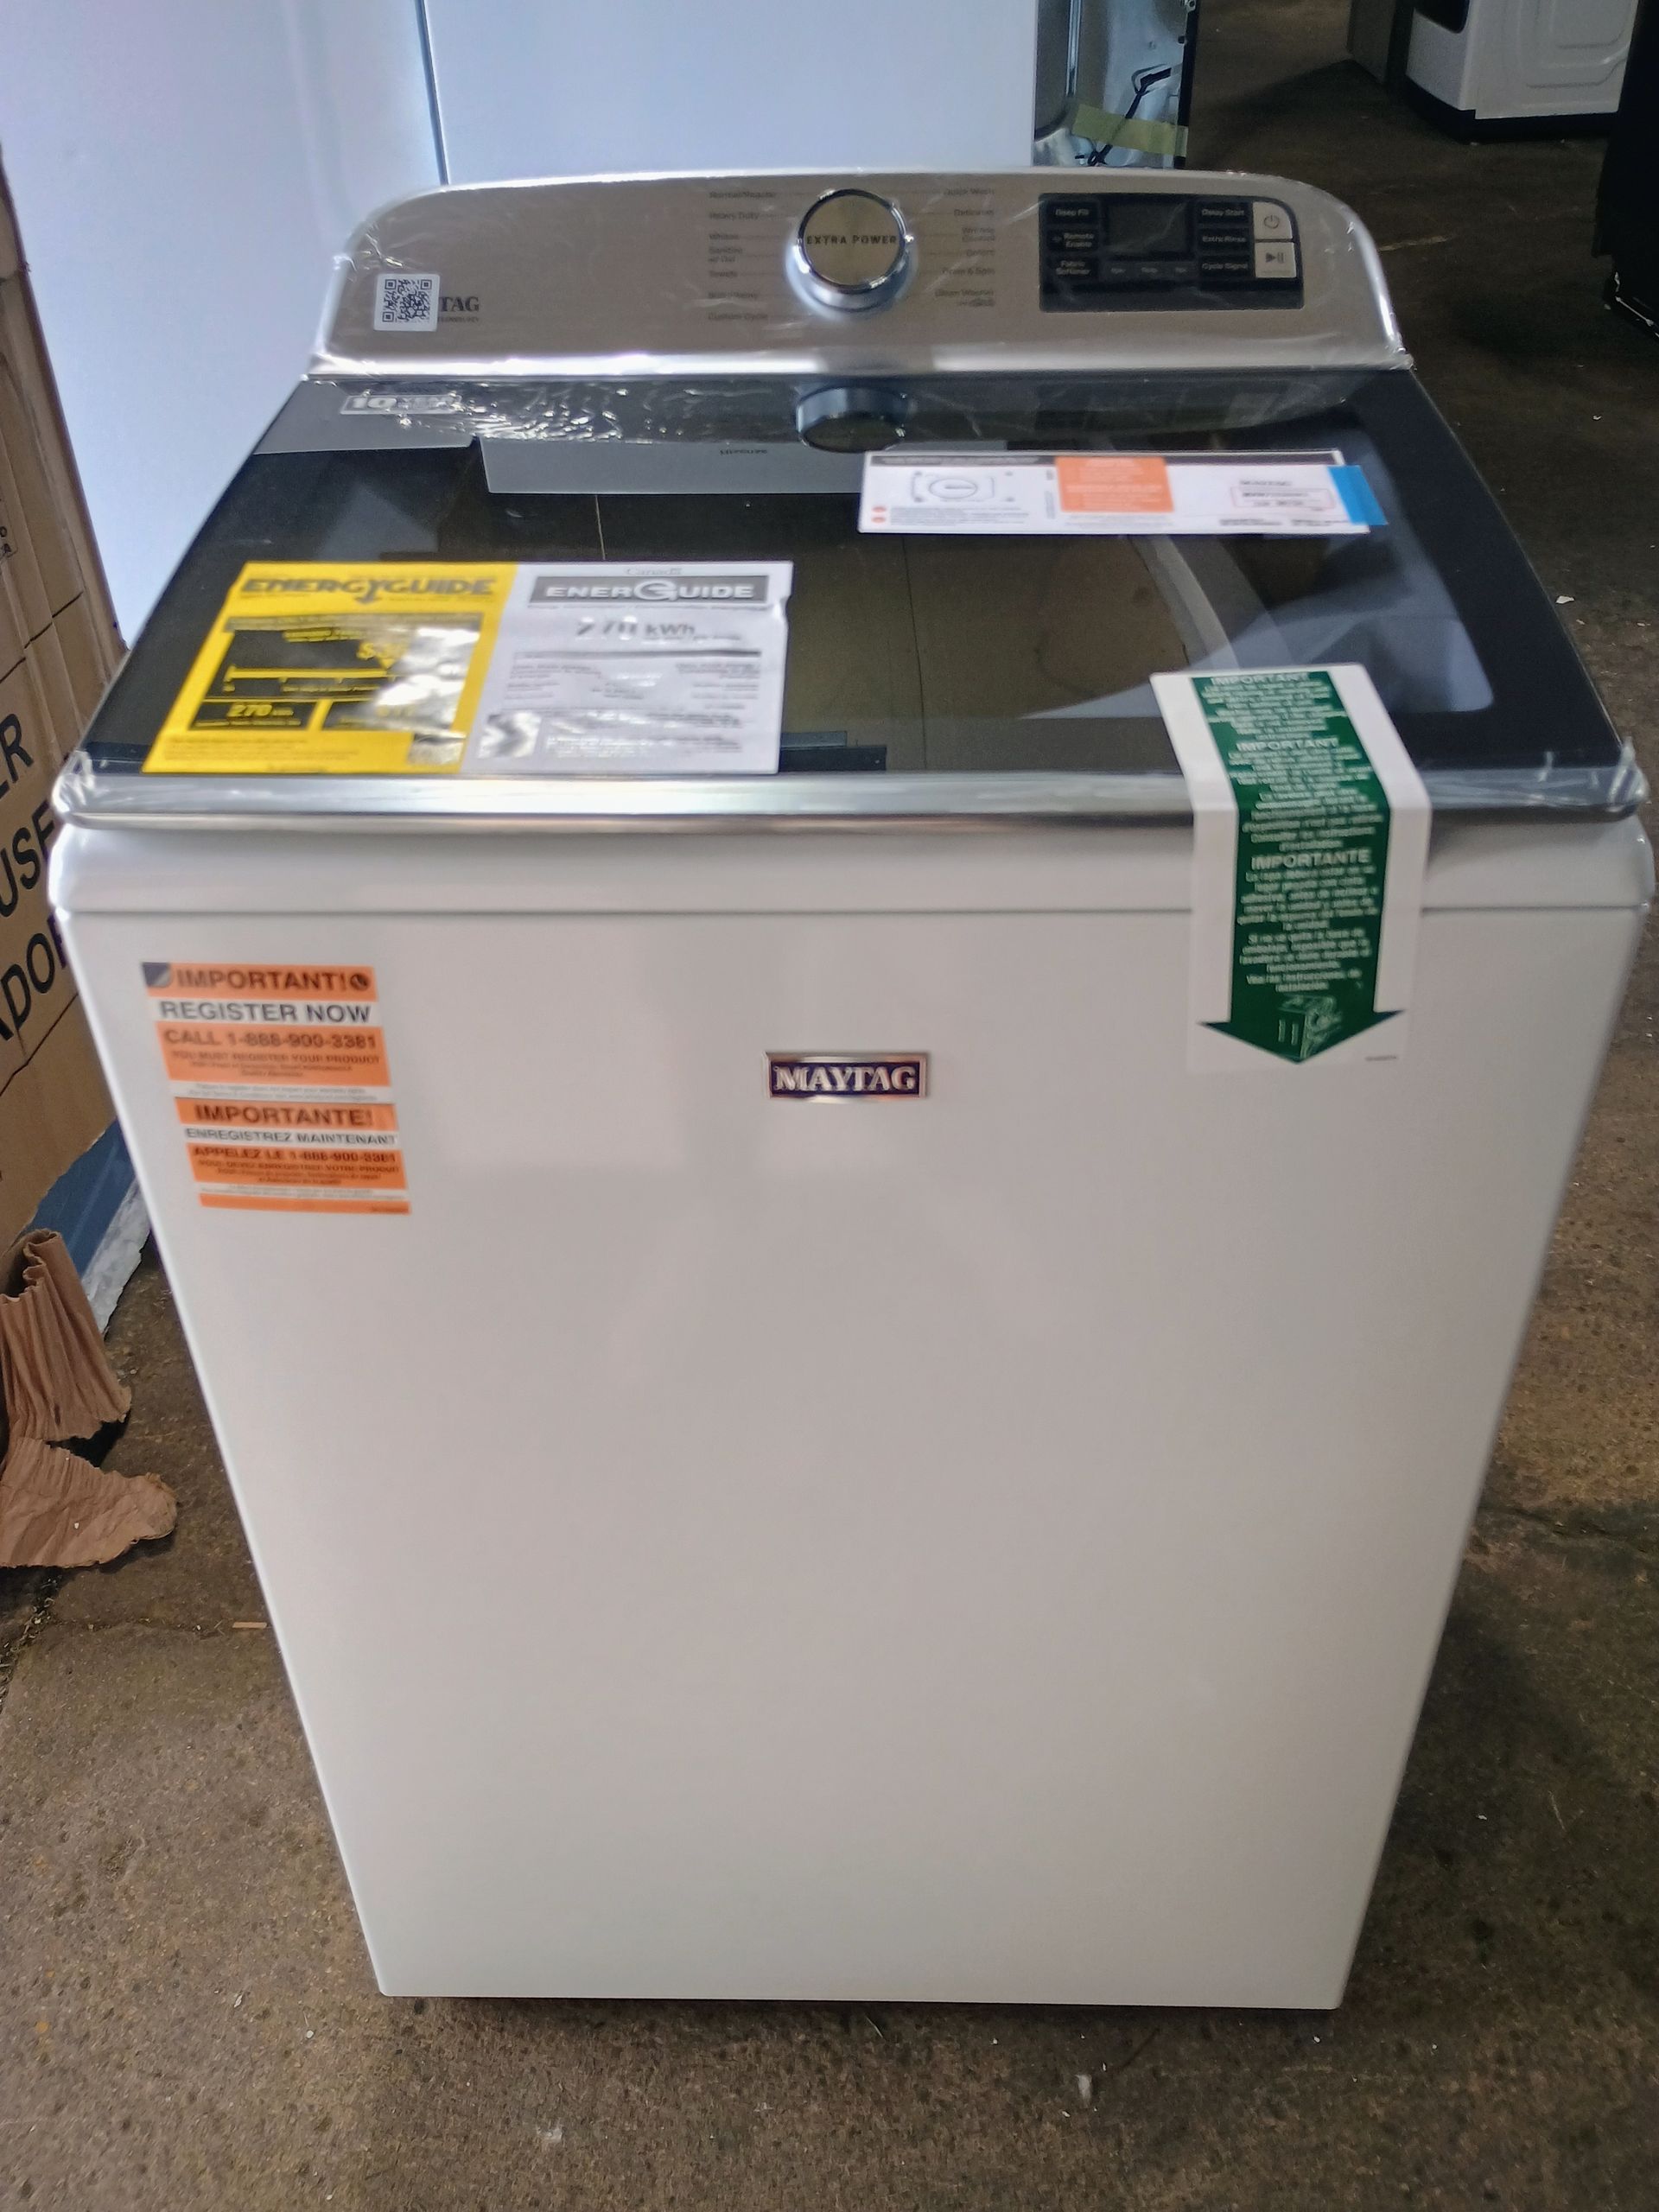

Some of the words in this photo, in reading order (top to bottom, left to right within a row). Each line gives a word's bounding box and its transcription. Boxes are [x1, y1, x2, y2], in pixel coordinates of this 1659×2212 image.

[807, 236, 848, 245] EXTRA
[852, 235, 898, 245] POWER
[439, 296, 480, 312] TAG
[242, 578, 496, 604] ENERGYGUIDE
[645, 623, 695, 639] kWh
[1211, 671, 1310, 685] IMPORTANT
[1236, 737, 1338, 752] IMPORTANT
[1251, 849, 1370, 870] IMPORTANTE
[177, 969, 346, 990] IMPORTANT!
[160, 1001, 297, 1021] REGISTER
[307, 1003, 372, 1023] NOW
[164, 1029, 221, 1046] CALL
[326, 1055, 380, 1065] PRODUCT
[773, 1066, 916, 1091] MAYTAG
[194, 1103, 374, 1127] IMPORTANTE!
[185, 1128, 292, 1143] ENREGISTREZ
[297, 1132, 397, 1146] MAINTENANT
[194, 1147, 261, 1159] APPELEZ
[265, 1148, 284, 1160] LE
